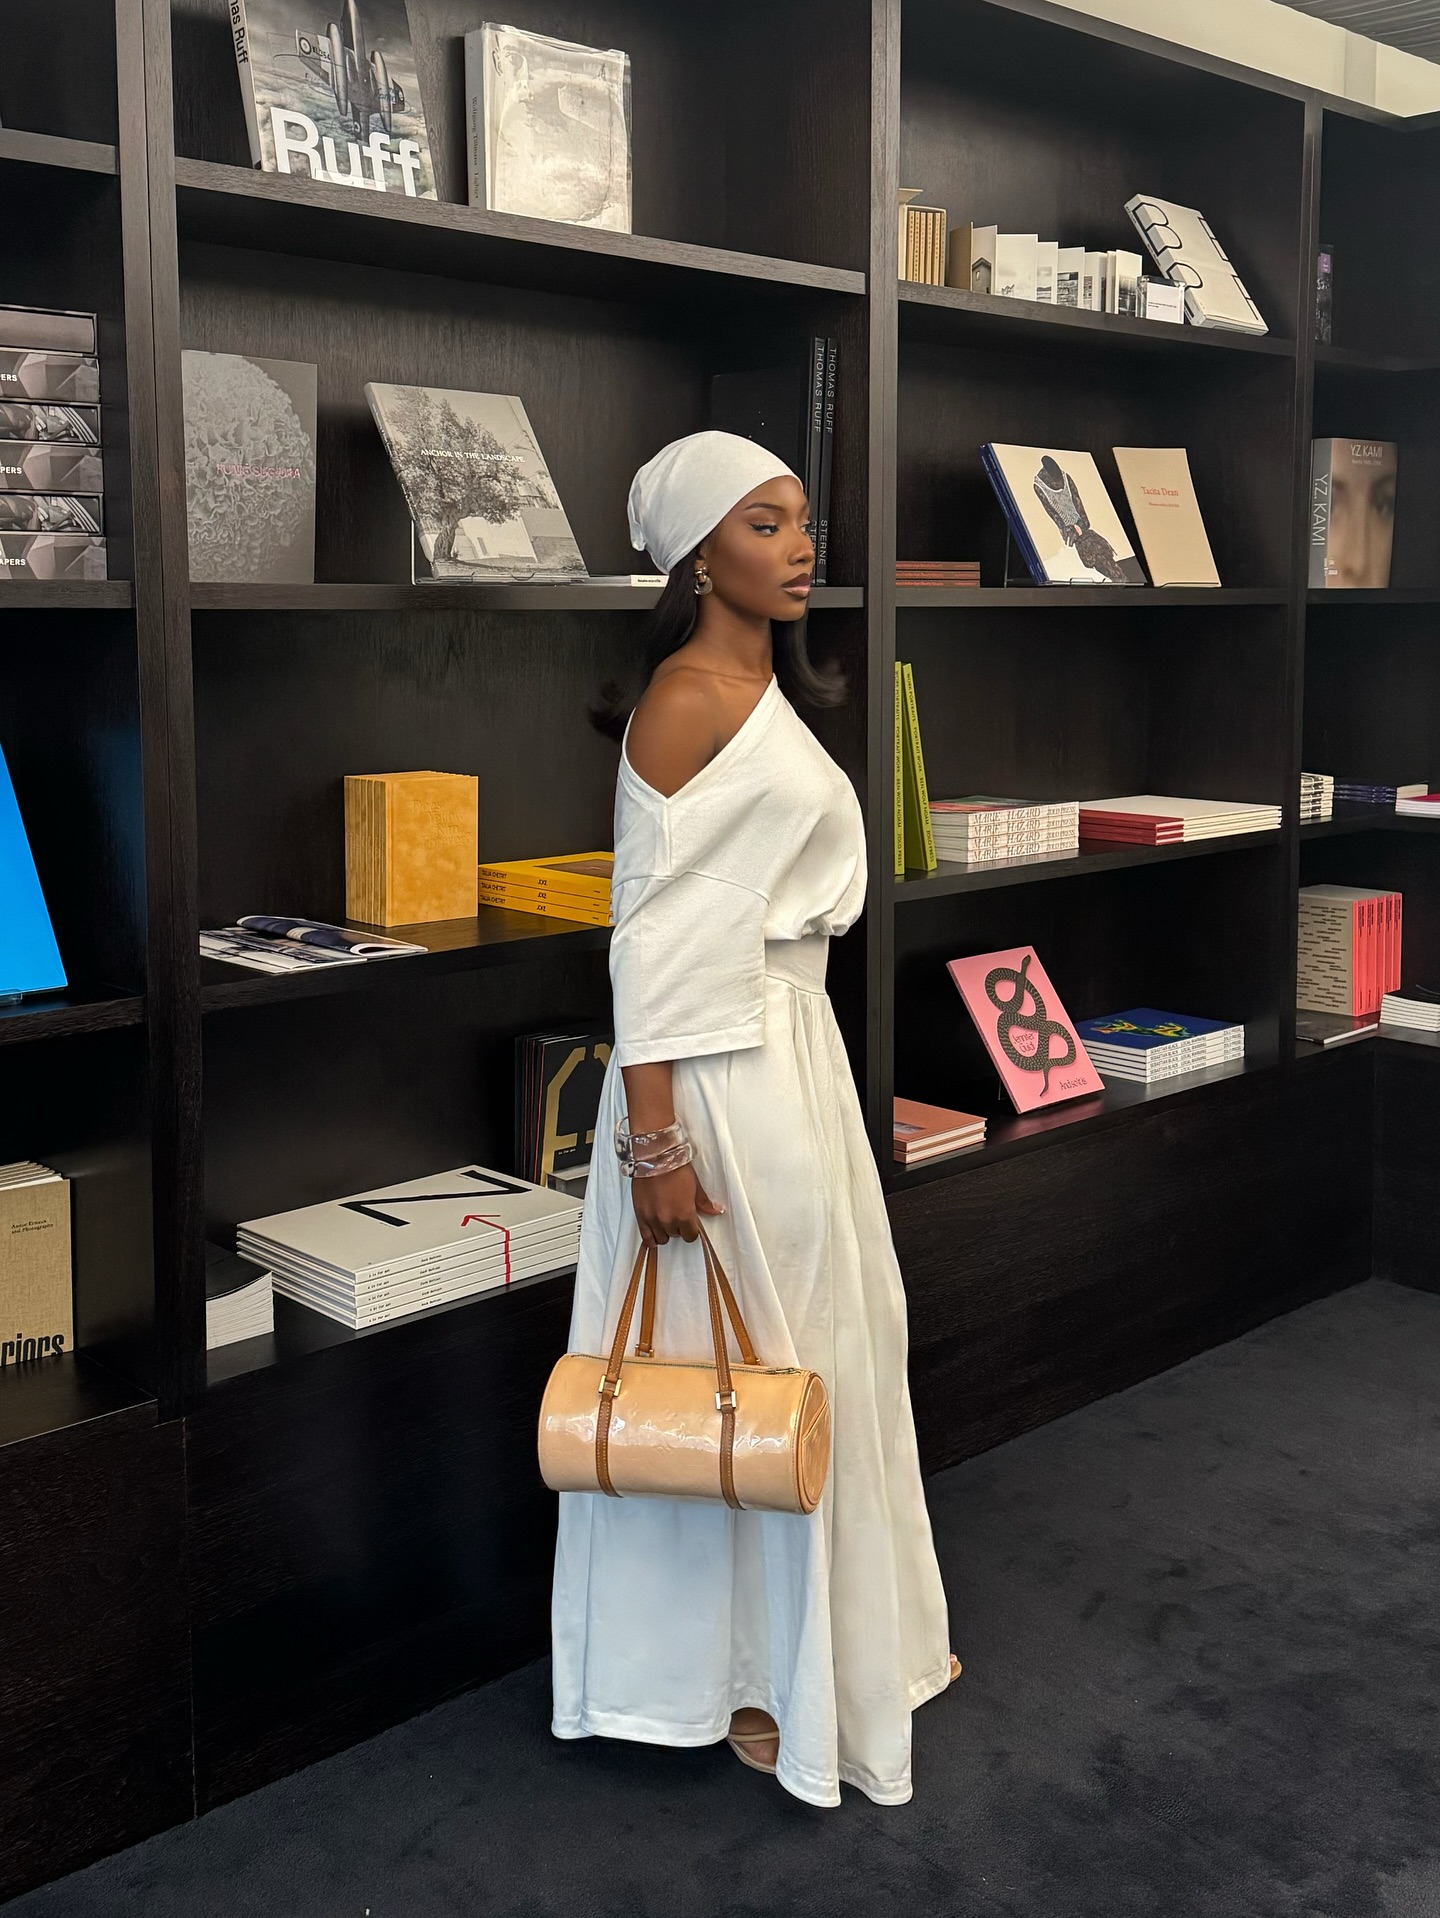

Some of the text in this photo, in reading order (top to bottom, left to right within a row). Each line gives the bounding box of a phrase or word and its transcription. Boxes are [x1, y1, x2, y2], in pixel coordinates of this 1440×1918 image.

[235, 27, 249, 64] Ruff
[270, 107, 421, 198] Ruff
[814, 346, 825, 433] THOMAS RUFF
[826, 348, 837, 434] THOMAS RUFF
[420, 449, 525, 463] ANCHOR IN THE LANDSCAPE
[1362, 445, 1383, 458] KAMI
[1140, 486, 1179, 496] Tacita Dean
[1312, 473, 1329, 546] Y.Z. KAMI
[818, 519, 828, 566] STERNE
[974, 811, 1000, 824] MARIE
[1007, 807, 1041, 820] HAZARD
[974, 823, 1000, 836] MARIE
[1007, 819, 1041, 832] HAZARD
[974, 835, 1000, 849] MARIE
[1007, 831, 1040, 844] HAZARD
[973, 847, 1000, 861] MARIE
[1007, 843, 1040, 856] HAZARD
[22, 1223, 54, 1232] Photography
[1, 1332, 65, 1366] riors
